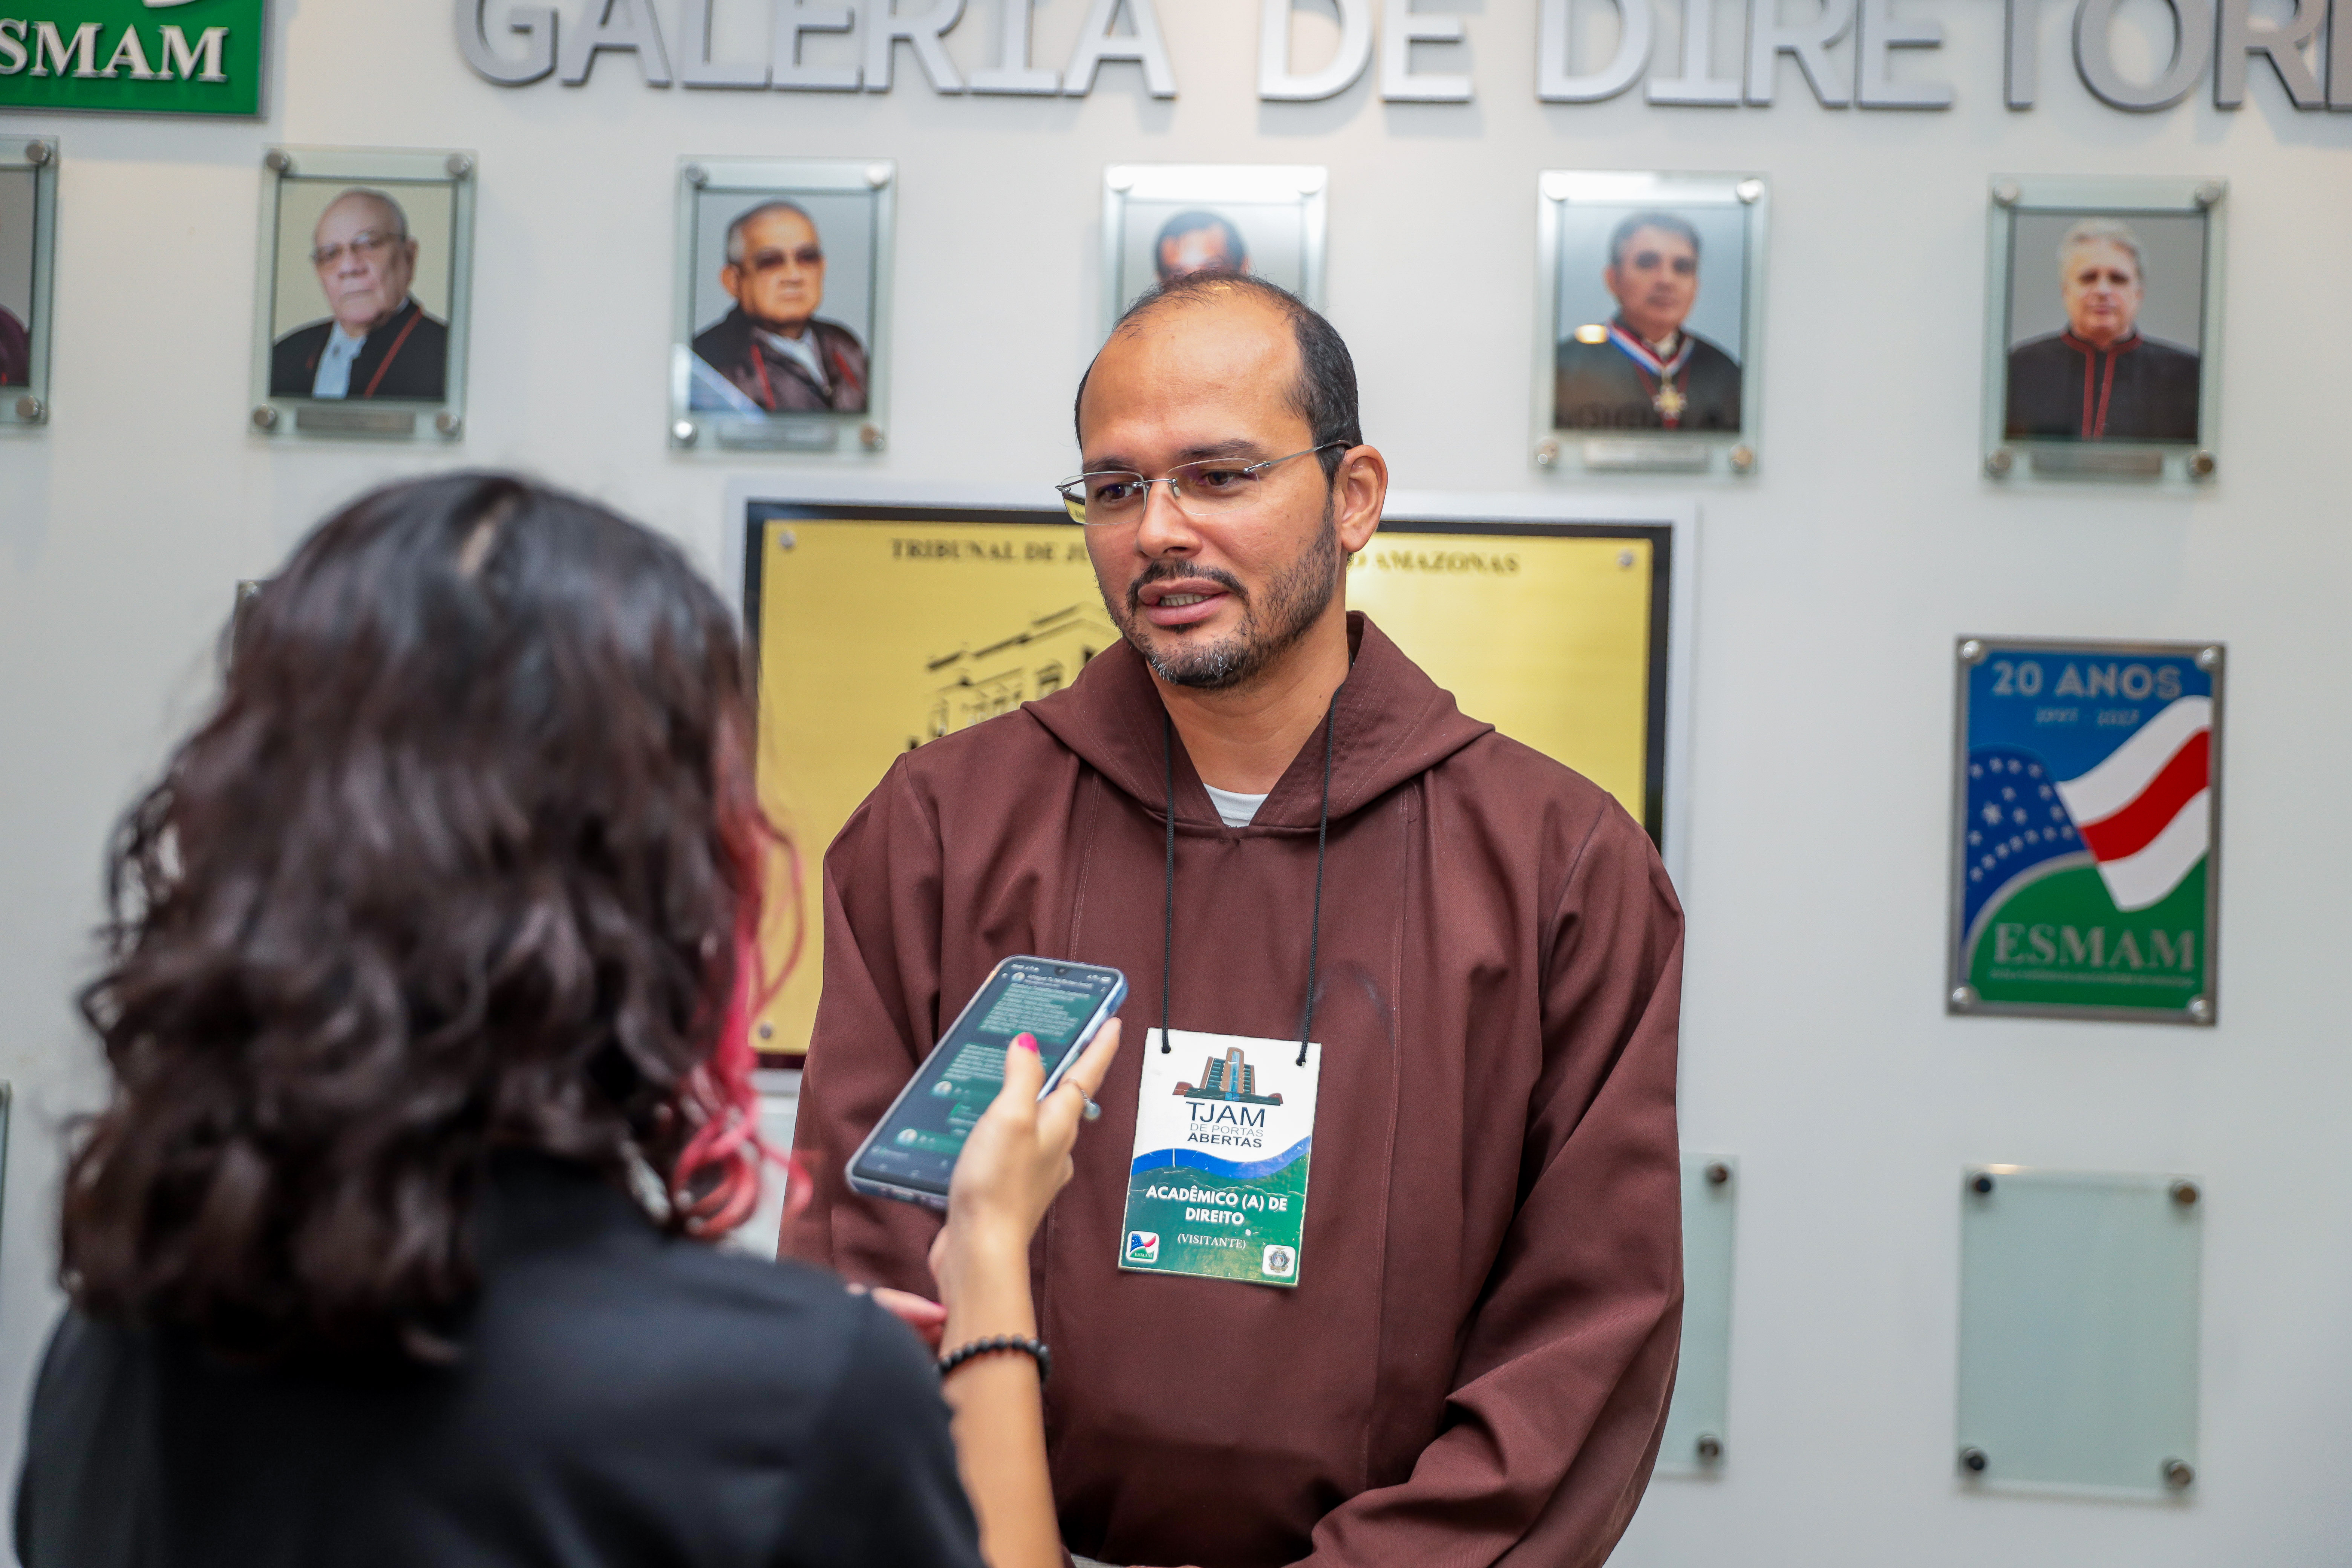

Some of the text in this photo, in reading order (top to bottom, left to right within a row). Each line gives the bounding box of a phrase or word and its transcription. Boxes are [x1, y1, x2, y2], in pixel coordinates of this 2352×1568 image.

[455, 0, 1177, 97] GALERIA
[1259, 0, 1473, 102] DE
[891, 538, 1017, 559] TRIBUNAL
[1024, 541, 1057, 561] DE
[1375, 550, 1521, 576] AMAZONAS
[1991, 660, 2182, 700] 20 ANOS
[1994, 922, 2196, 972] ESMAM
[1186, 1101, 1265, 1127] TJAM
[1187, 1132, 1262, 1147] ABERTAS
[1190, 1123, 1263, 1137] DE PORTAS
[1145, 1185, 1288, 1212] ACADÊMICO (A) DE
[1185, 1207, 1244, 1225] DIREITO
[1178, 1233, 1246, 1250] (VISITANTE)
